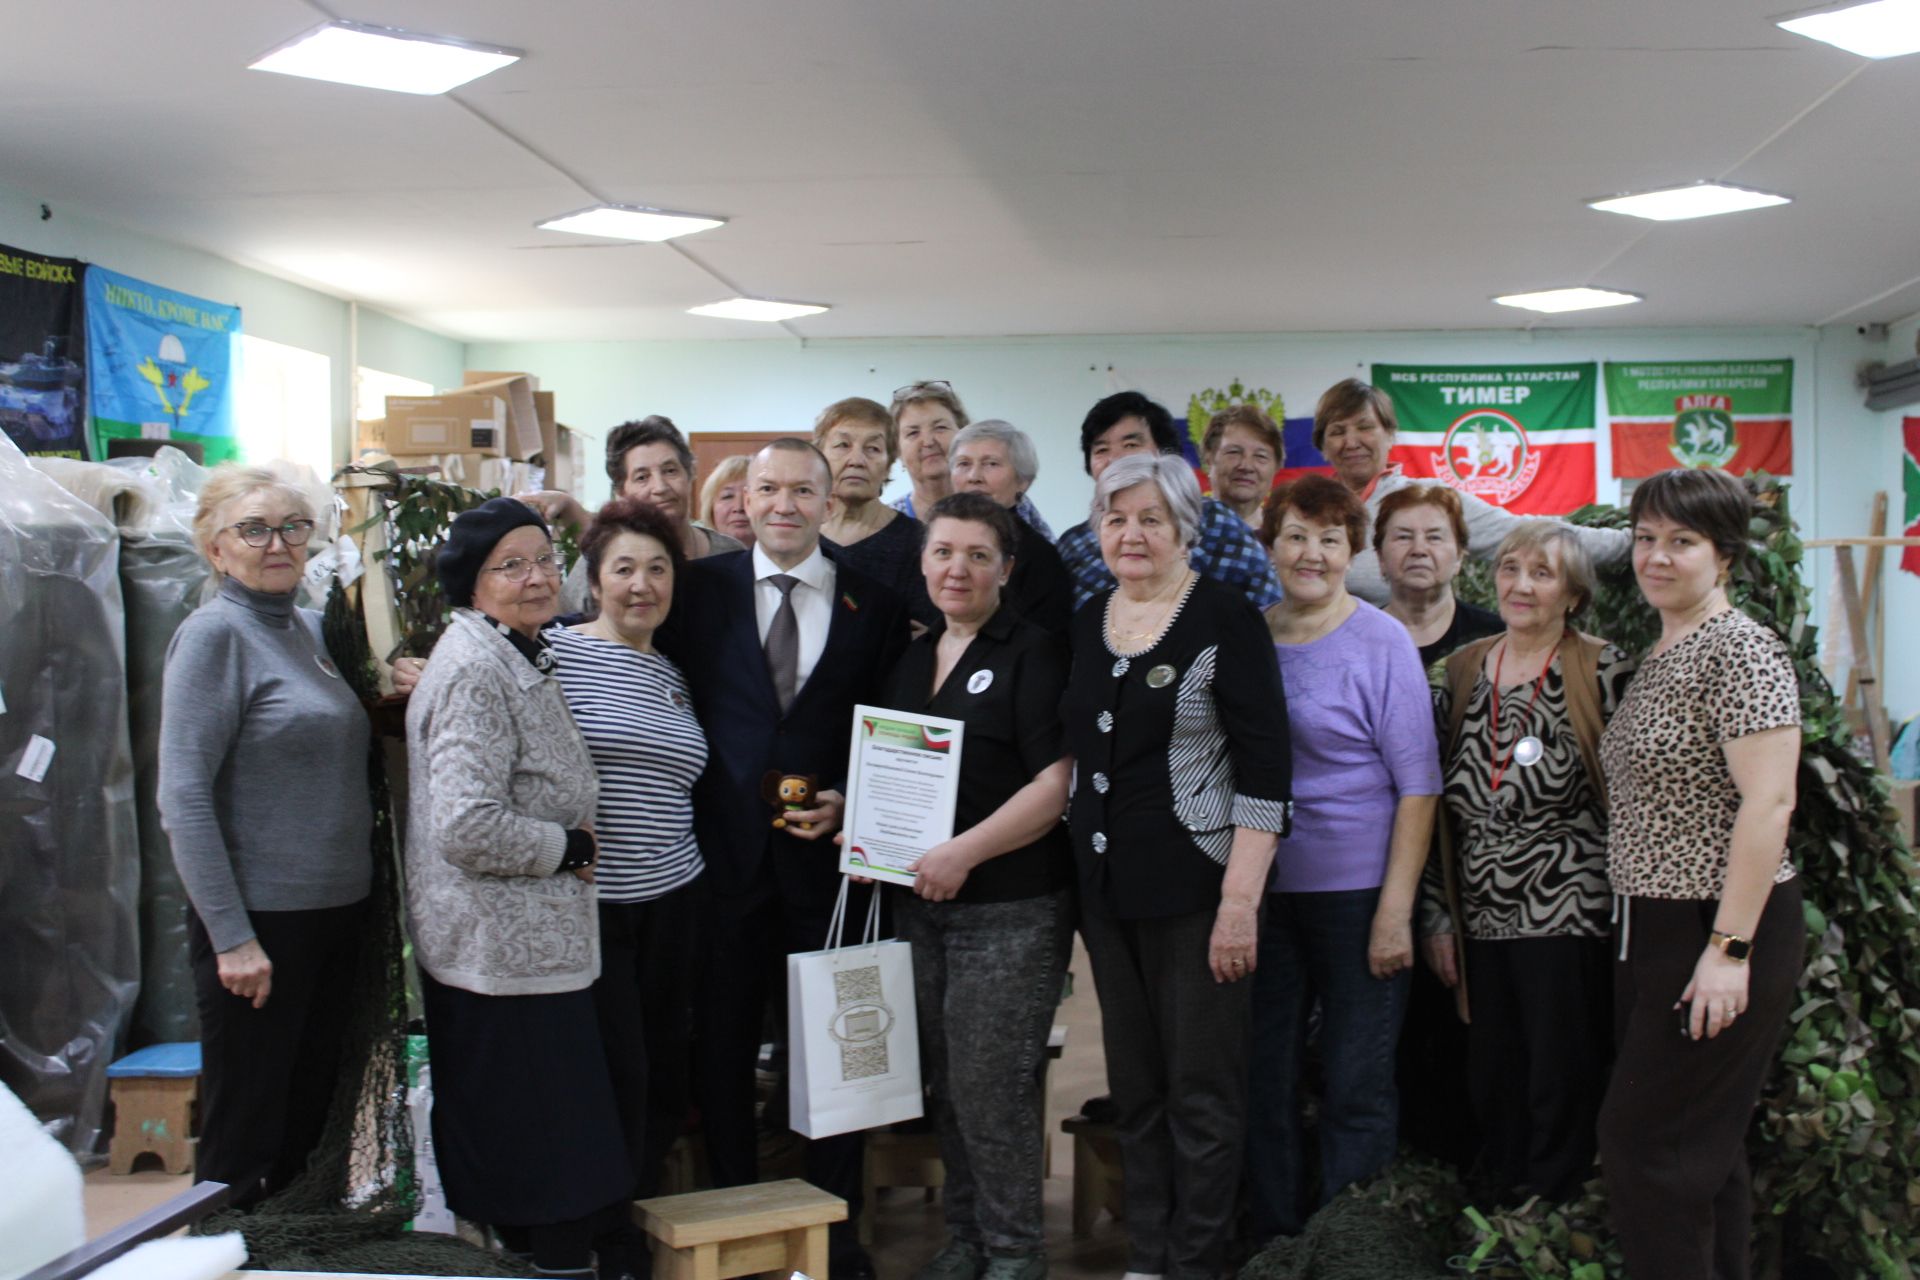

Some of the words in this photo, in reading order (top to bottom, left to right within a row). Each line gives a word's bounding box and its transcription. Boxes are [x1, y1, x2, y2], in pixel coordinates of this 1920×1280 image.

[26, 258, 77, 283] ВОЙСКА
[1420, 372, 1504, 384] РЕСПУБЛИКА
[1506, 370, 1581, 383] ТАТАРСТАН
[1439, 386, 1532, 405] ТИМЕР
[1680, 394, 1726, 410] АЛГА
